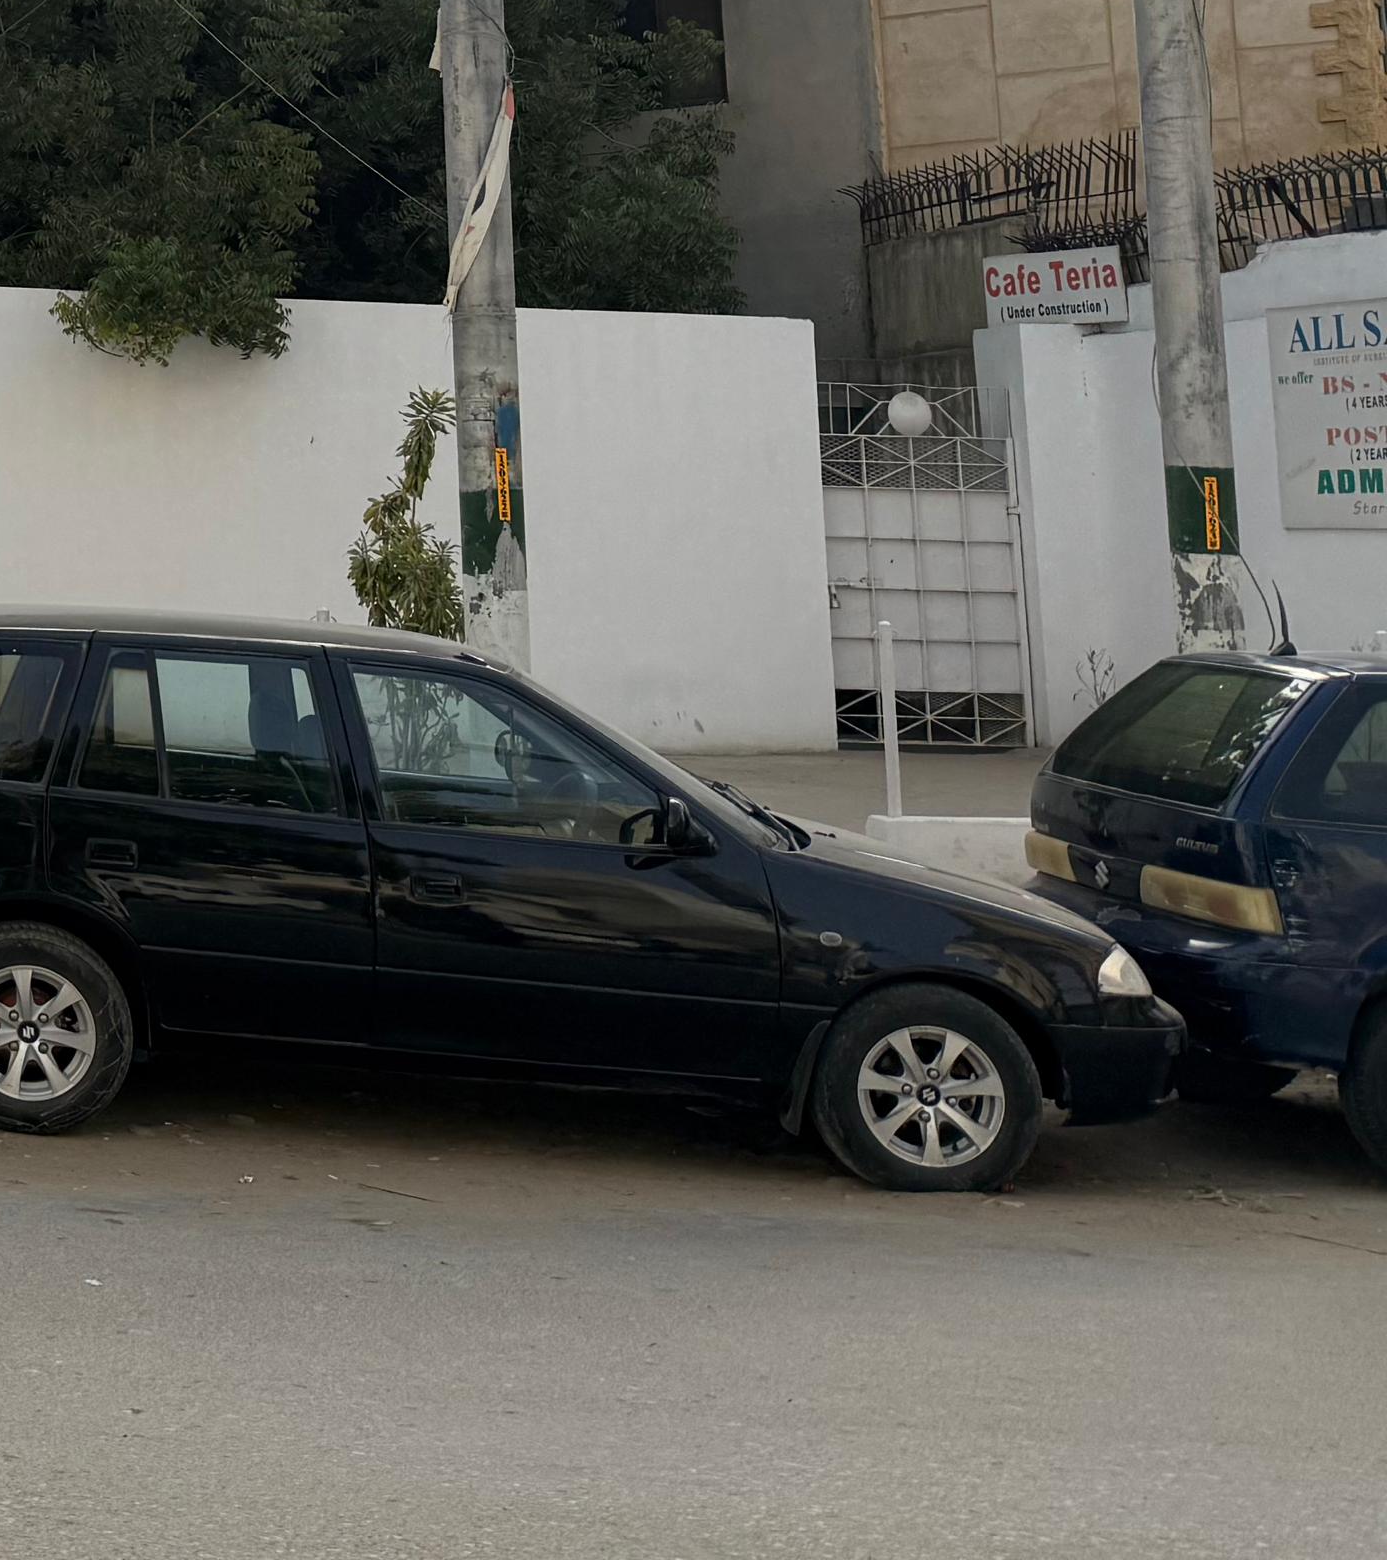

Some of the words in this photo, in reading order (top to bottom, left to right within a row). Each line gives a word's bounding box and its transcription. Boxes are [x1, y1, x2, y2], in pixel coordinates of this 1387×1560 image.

[986, 264, 1041, 298] Cafe
[1049, 257, 1118, 291] Teria
[1038, 300, 1102, 316] Construction
[1289, 313, 1356, 353] ALL
[1291, 371, 1314, 385] offer
[1323, 374, 1356, 395] BS
